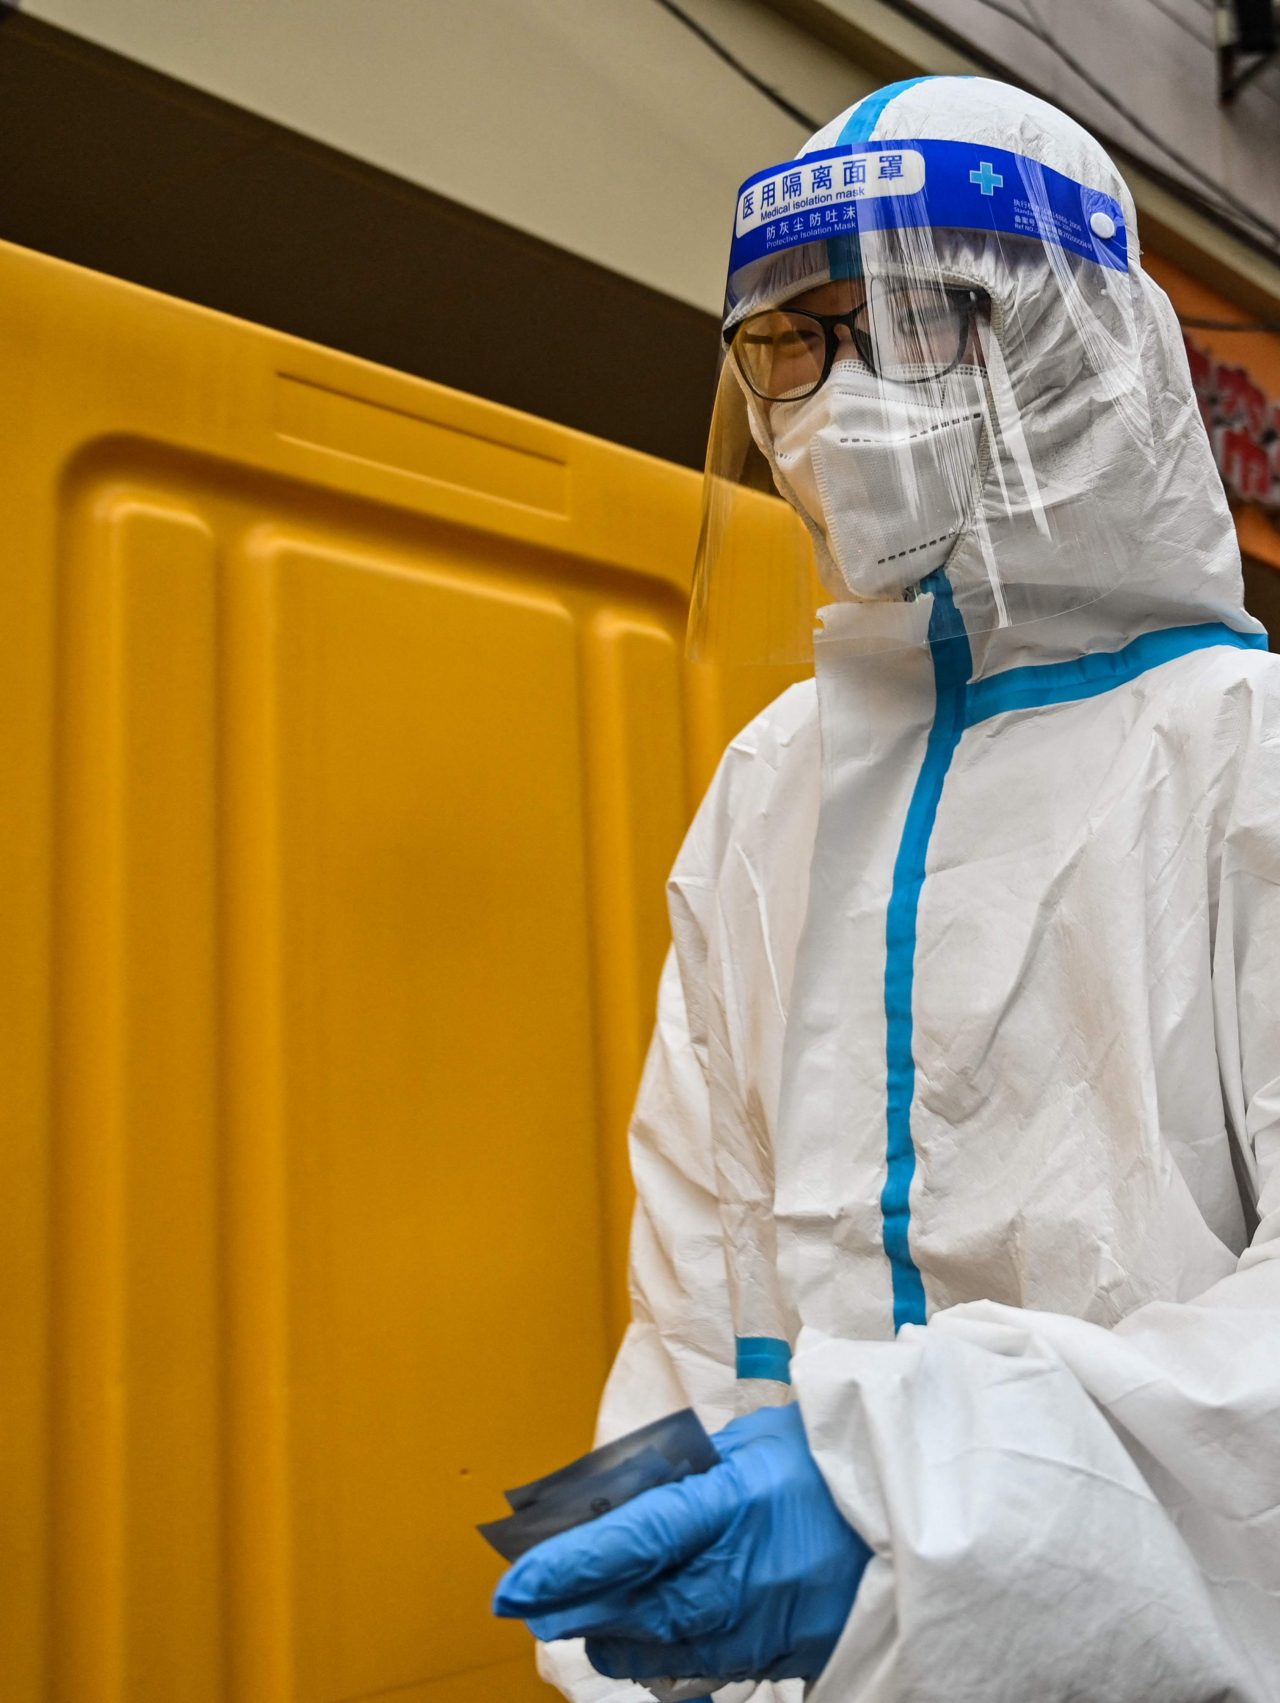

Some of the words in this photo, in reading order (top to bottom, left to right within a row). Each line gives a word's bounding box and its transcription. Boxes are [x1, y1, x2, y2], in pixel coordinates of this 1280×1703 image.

[743, 155, 904, 220] 医用隔离面罩
[760, 203, 791, 222] Medical
[793, 193, 833, 210] isolation
[836, 187, 865, 201] mask
[766, 233, 799, 249] Protective
[800, 224, 832, 239] Isolation
[834, 221, 857, 232] Mask
